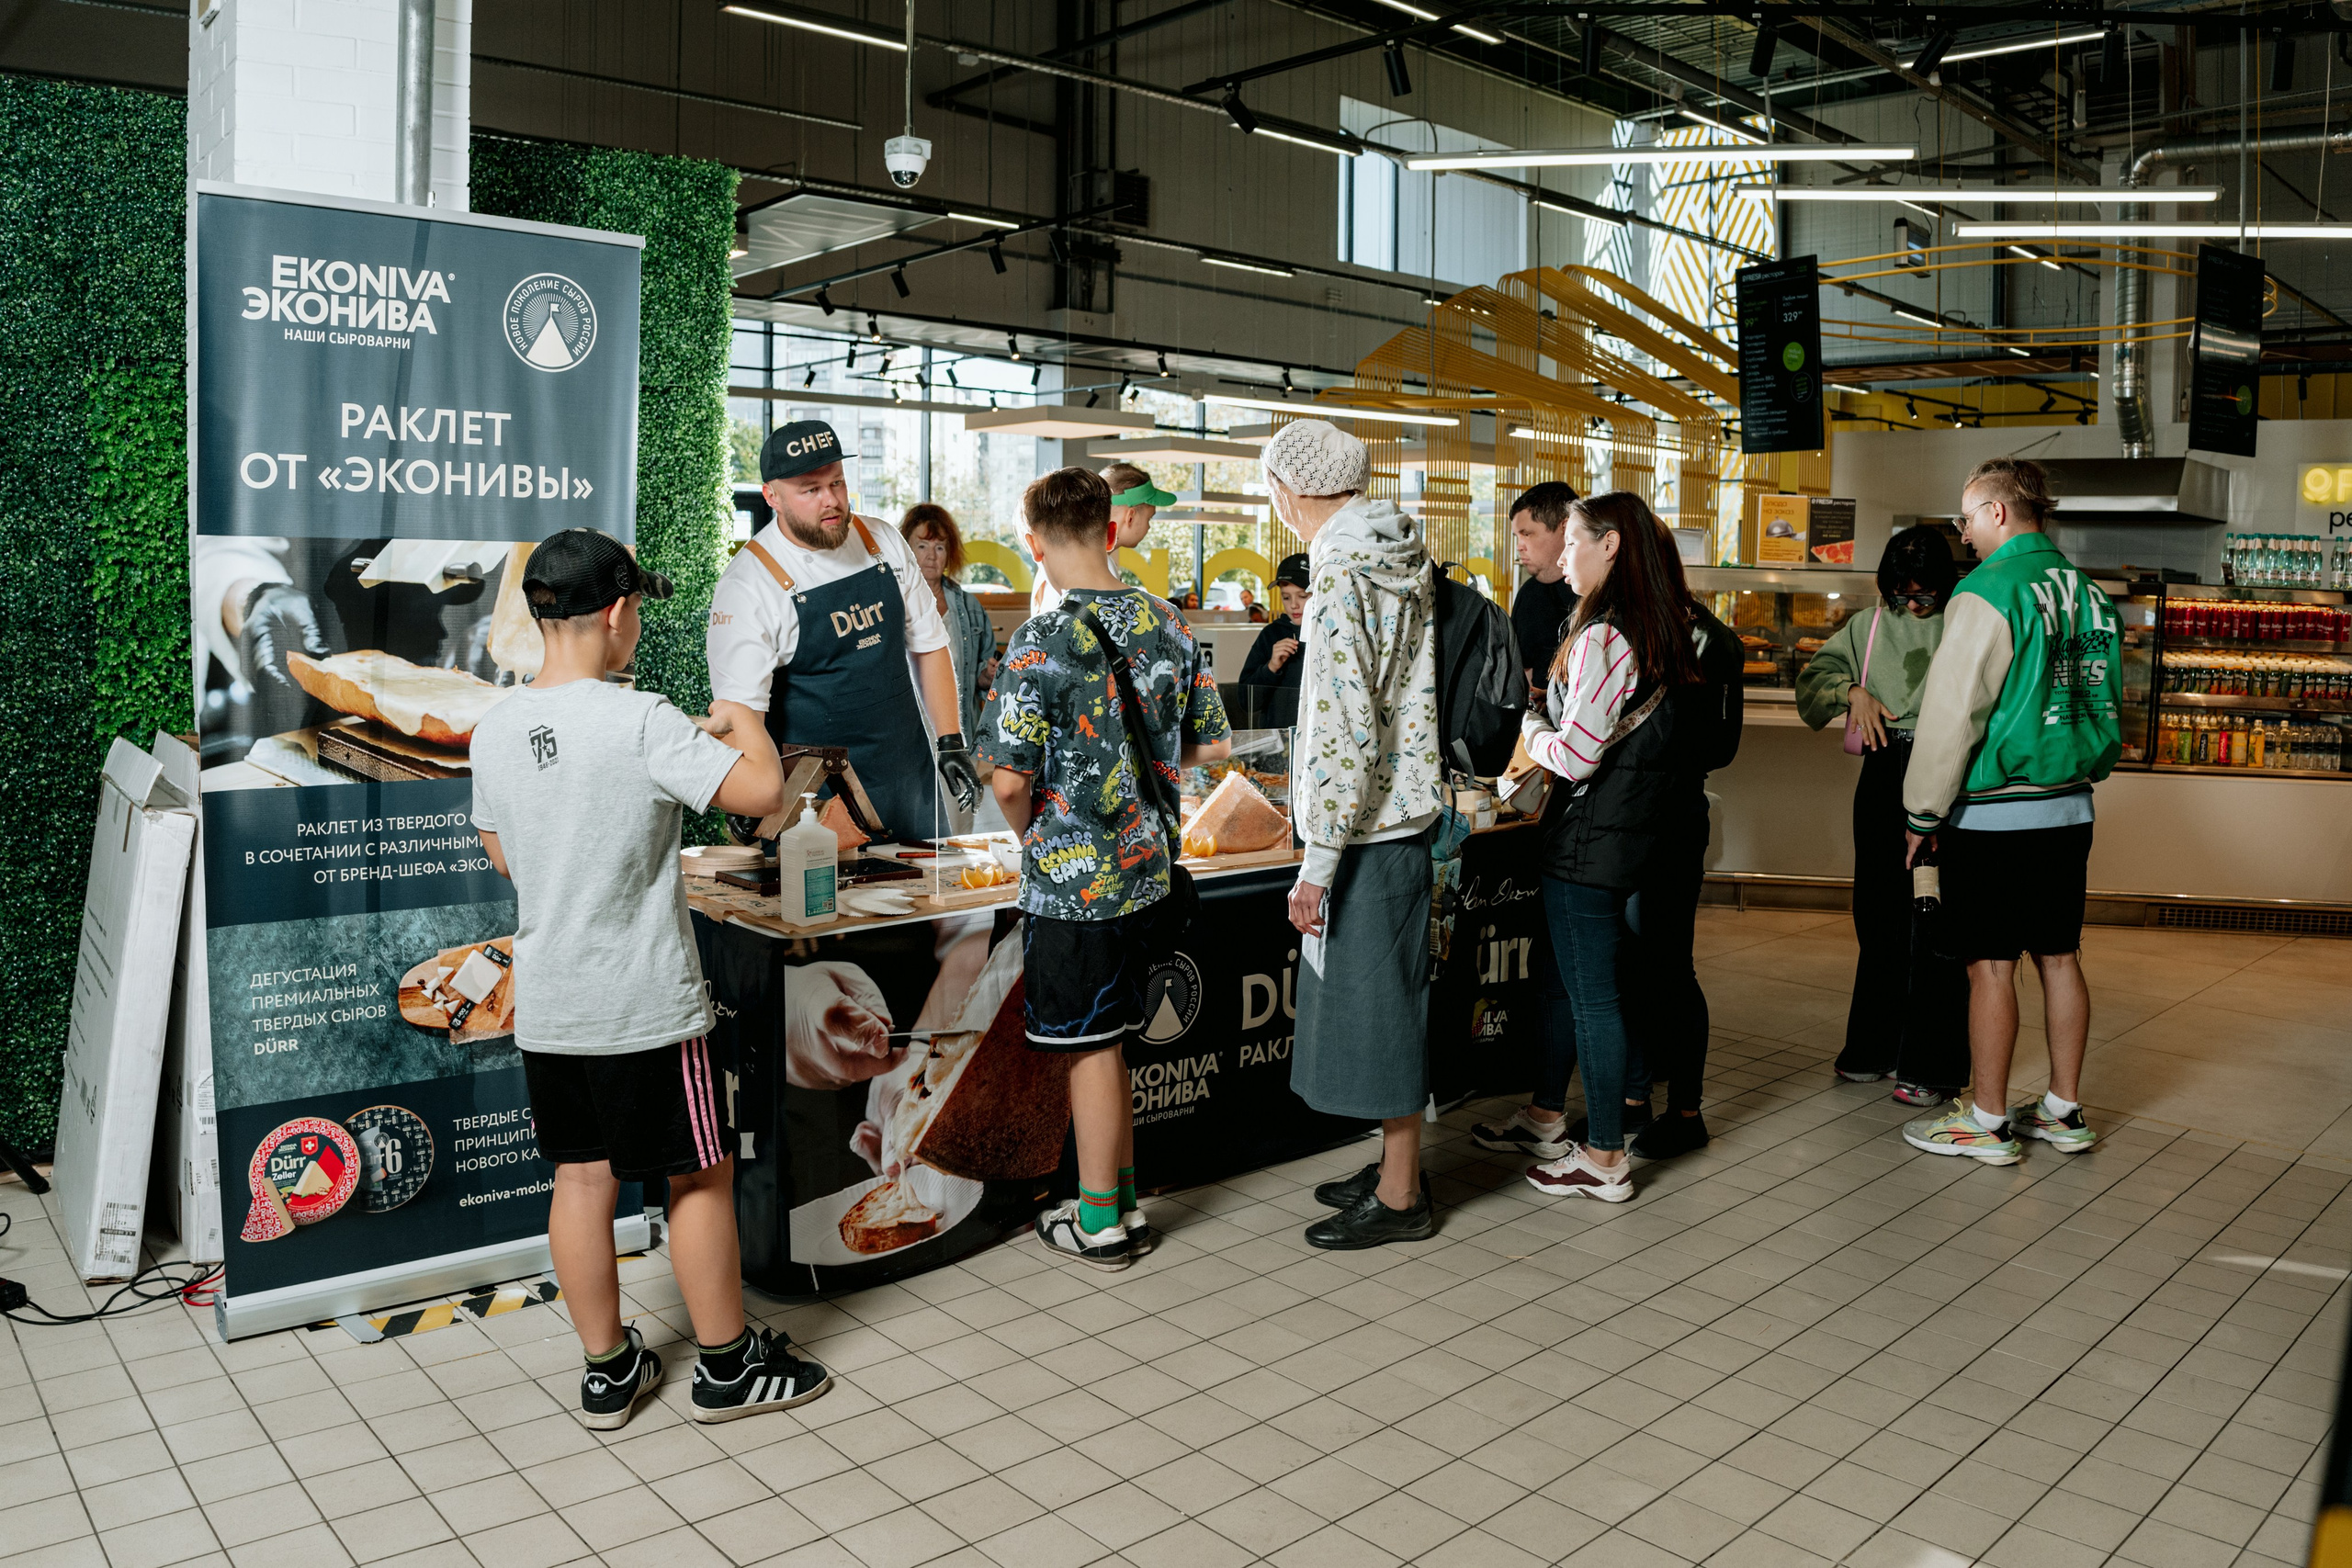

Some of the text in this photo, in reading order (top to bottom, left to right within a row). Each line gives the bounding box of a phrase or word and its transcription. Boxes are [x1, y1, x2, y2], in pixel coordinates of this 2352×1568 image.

[272, 254, 451, 304] EKONIVA
[242, 288, 437, 334] ЭКОНИВА
[509, 278, 592, 358] НОВОЕ ПОКОЛЕНИЕ СЫРОВ РОССИИ
[284, 328, 411, 350] НАШИ СЫРОВАРНИ
[341, 402, 512, 446] РАКЛЕТ
[786, 431, 835, 457] CHEF
[240, 452, 594, 501] ОТ «ЭКОНИВЫ»
[1764, 498, 1787, 507] Блюда
[2029, 567, 2117, 640] NYC
[712, 612, 733, 626] Dürr
[830, 601, 884, 638] Dürr
[530, 728, 557, 763] 75
[297, 819, 359, 837] РАКЛЕТ
[362, 818, 383, 833] ИЗ
[386, 813, 467, 831] ТВЕРДОГО
[245, 851, 255, 865] В
[259, 843, 361, 863] СОЧЕТАНИИ
[365, 842, 376, 856] С
[1031, 830, 1092, 860] GAMERS
[1038, 843, 1098, 874] GONNA
[313, 869, 337, 884] ОТ
[340, 861, 447, 883] БРЕНД-ШЕФА
[1049, 856, 1097, 884] GAME
[1094, 872, 1121, 885] STAY
[1089, 880, 1125, 895] CREATIVE
[1476, 924, 1532, 985] ürr
[250, 964, 357, 988] ДЕГУСТАЦИЯ
[252, 983, 380, 1010] ПРЕМИАЛЬНЫХ
[1175, 958, 1198, 1023] СЫРОВ РОССИИ
[252, 1005, 387, 1032] ТВЕРДЫХ СЫРОВ
[254, 1038, 300, 1055] DÜRR
[1133, 1077, 1211, 1114] ОНИВА
[453, 1109, 519, 1132] ТВЕРДЫЕ
[1147, 1106, 1194, 1124] СЫРОВАРНИ
[270, 1155, 307, 1173] Dürr
[386, 1138, 402, 1173] 6
[456, 1151, 518, 1173] НОВОГО
[272, 1170, 297, 1181] Zeller
